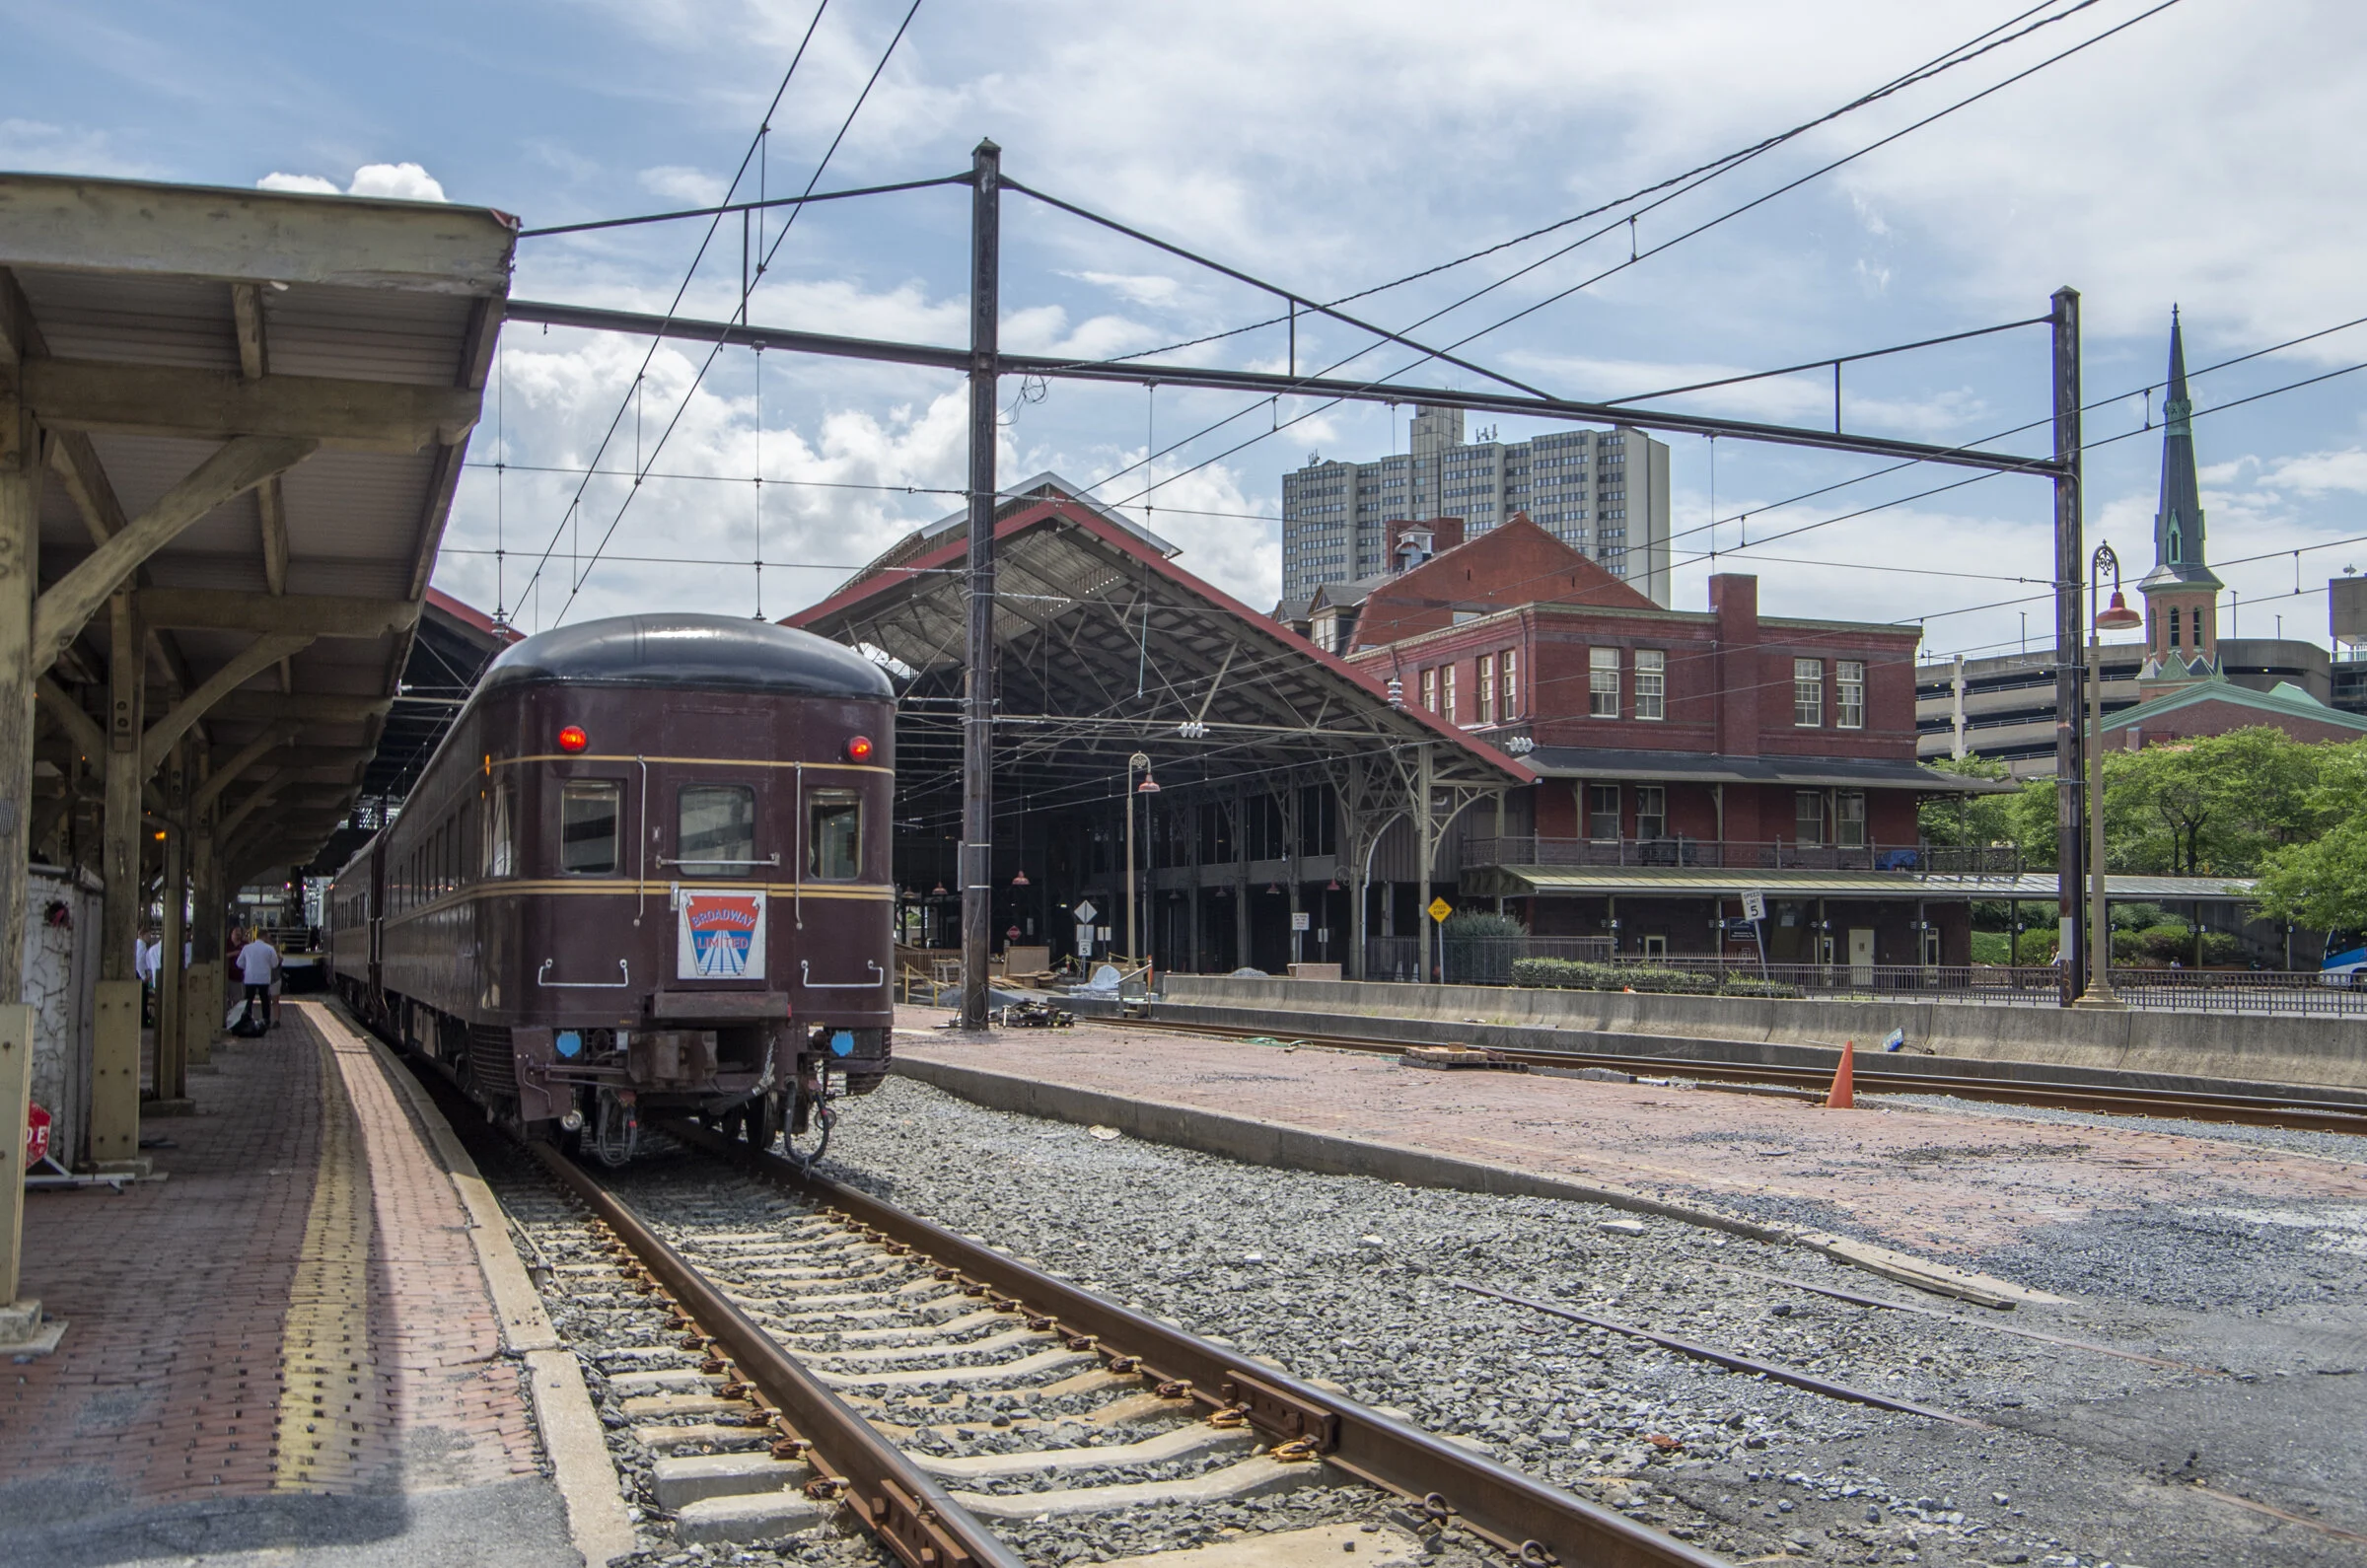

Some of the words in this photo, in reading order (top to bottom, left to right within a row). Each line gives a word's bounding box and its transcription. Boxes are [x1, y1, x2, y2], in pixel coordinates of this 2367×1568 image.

[1743, 891, 1760, 899] SPEED
[1751, 905, 1758, 916] 5
[691, 909, 756, 928] BROADWAY
[1611, 919, 1617, 928] 2
[1718, 919, 1725, 928] 3
[1822, 920, 1828, 929] 4
[698, 938, 748, 950] LIMITED
